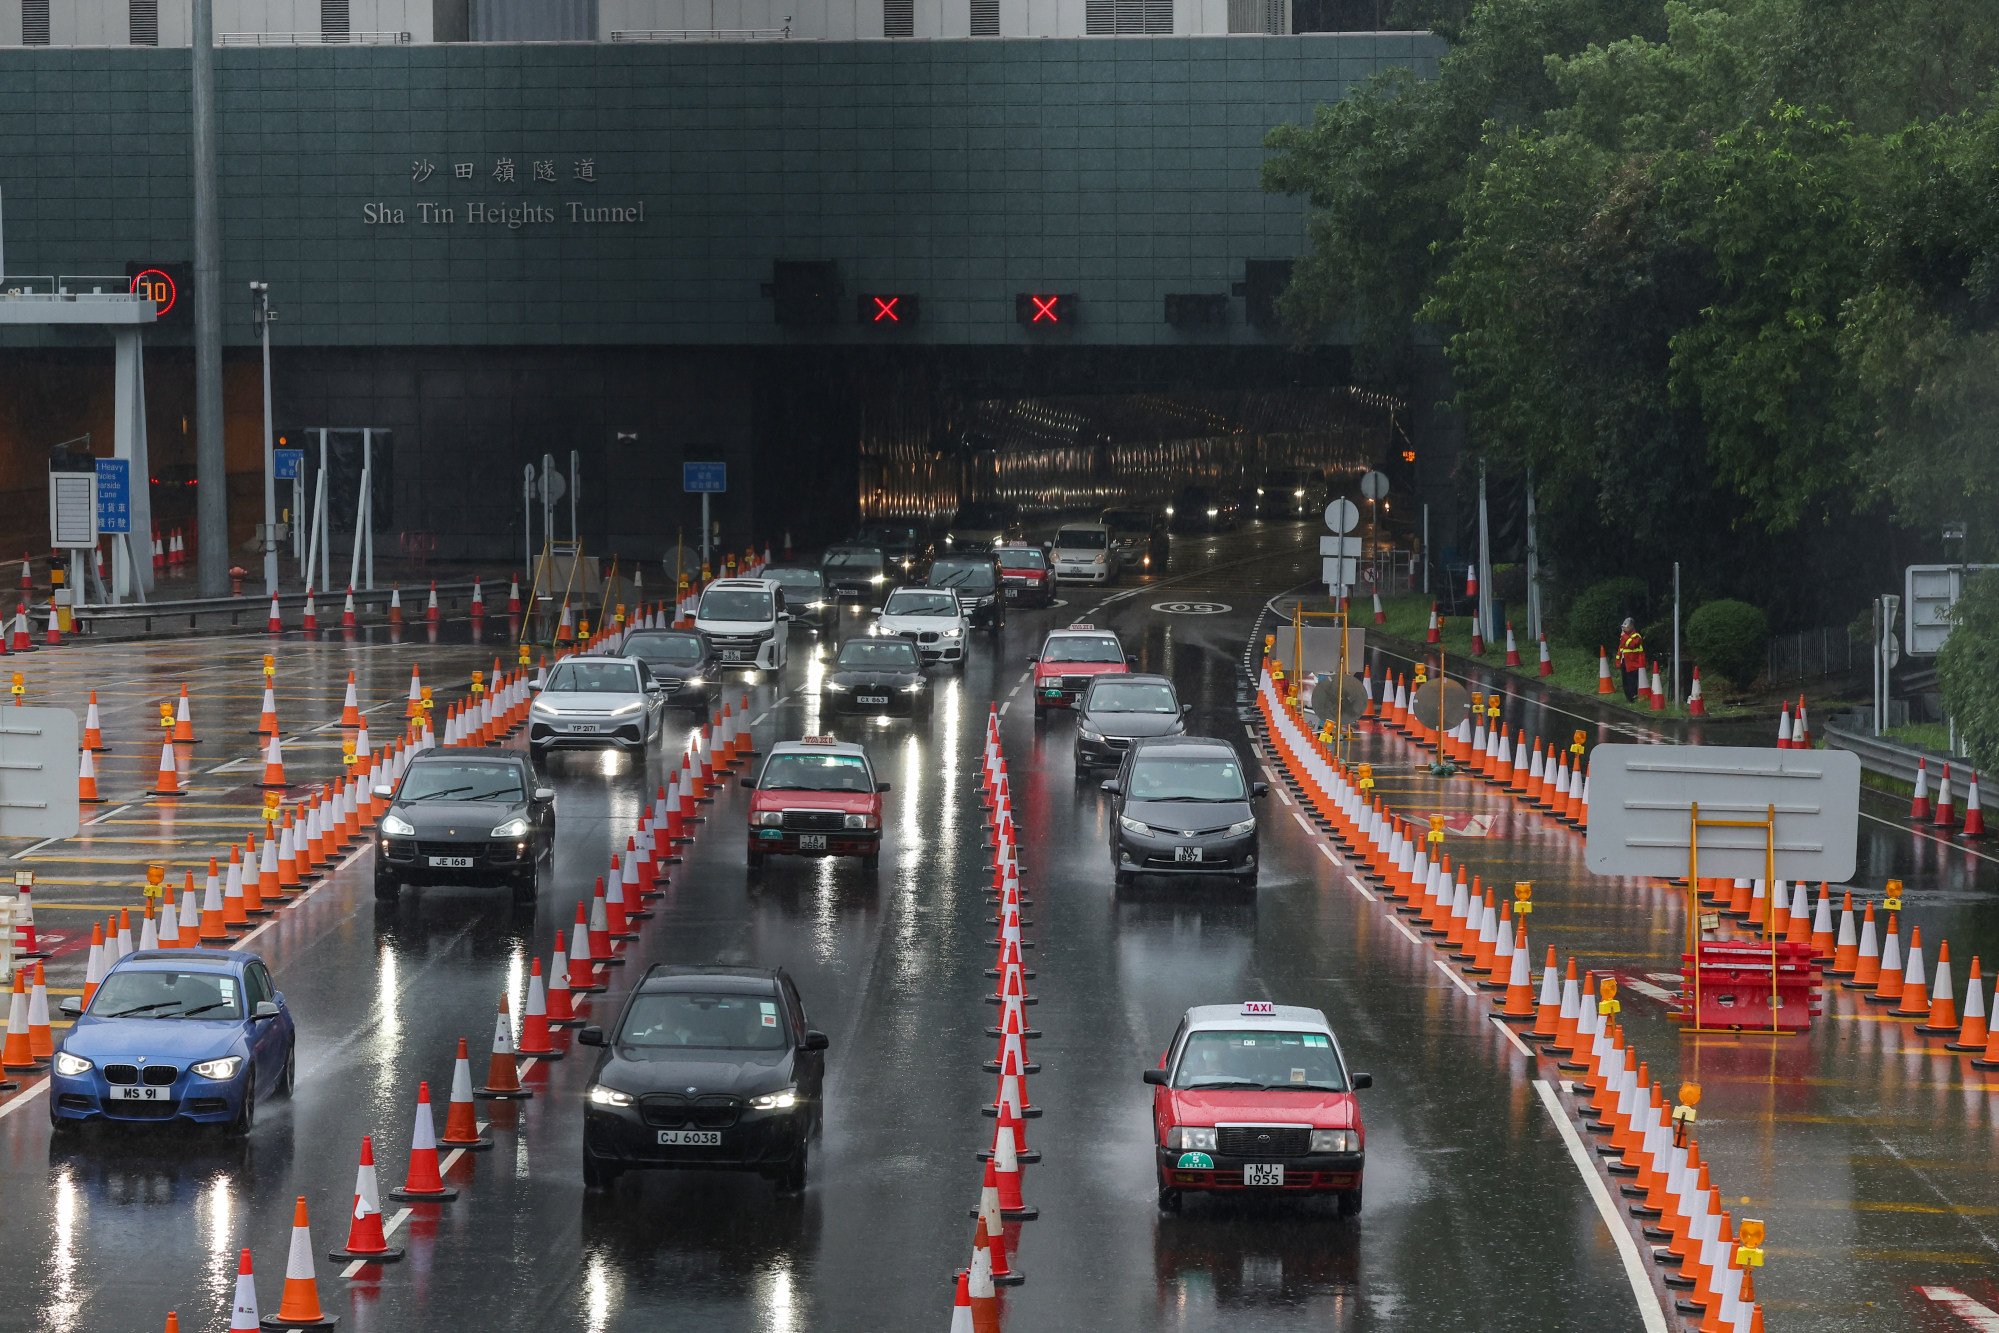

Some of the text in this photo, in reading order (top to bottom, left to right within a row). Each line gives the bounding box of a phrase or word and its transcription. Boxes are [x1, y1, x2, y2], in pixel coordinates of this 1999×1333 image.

[412, 157, 598, 183] 沙田嶺隧道
[363, 201, 644, 229] Sha Tin Heights Tunnel
[101, 463, 123, 472] Heavy
[804, 736, 833, 744] TAXI
[1183, 846, 1195, 855] NX
[436, 858, 467, 866] JE 168
[1246, 1003, 1272, 1012] TAXI
[124, 1088, 156, 1099] MS 91
[661, 1132, 718, 1144] CJ 6038
[1255, 1165, 1273, 1174] MJ
[1249, 1174, 1279, 1185] 1955
